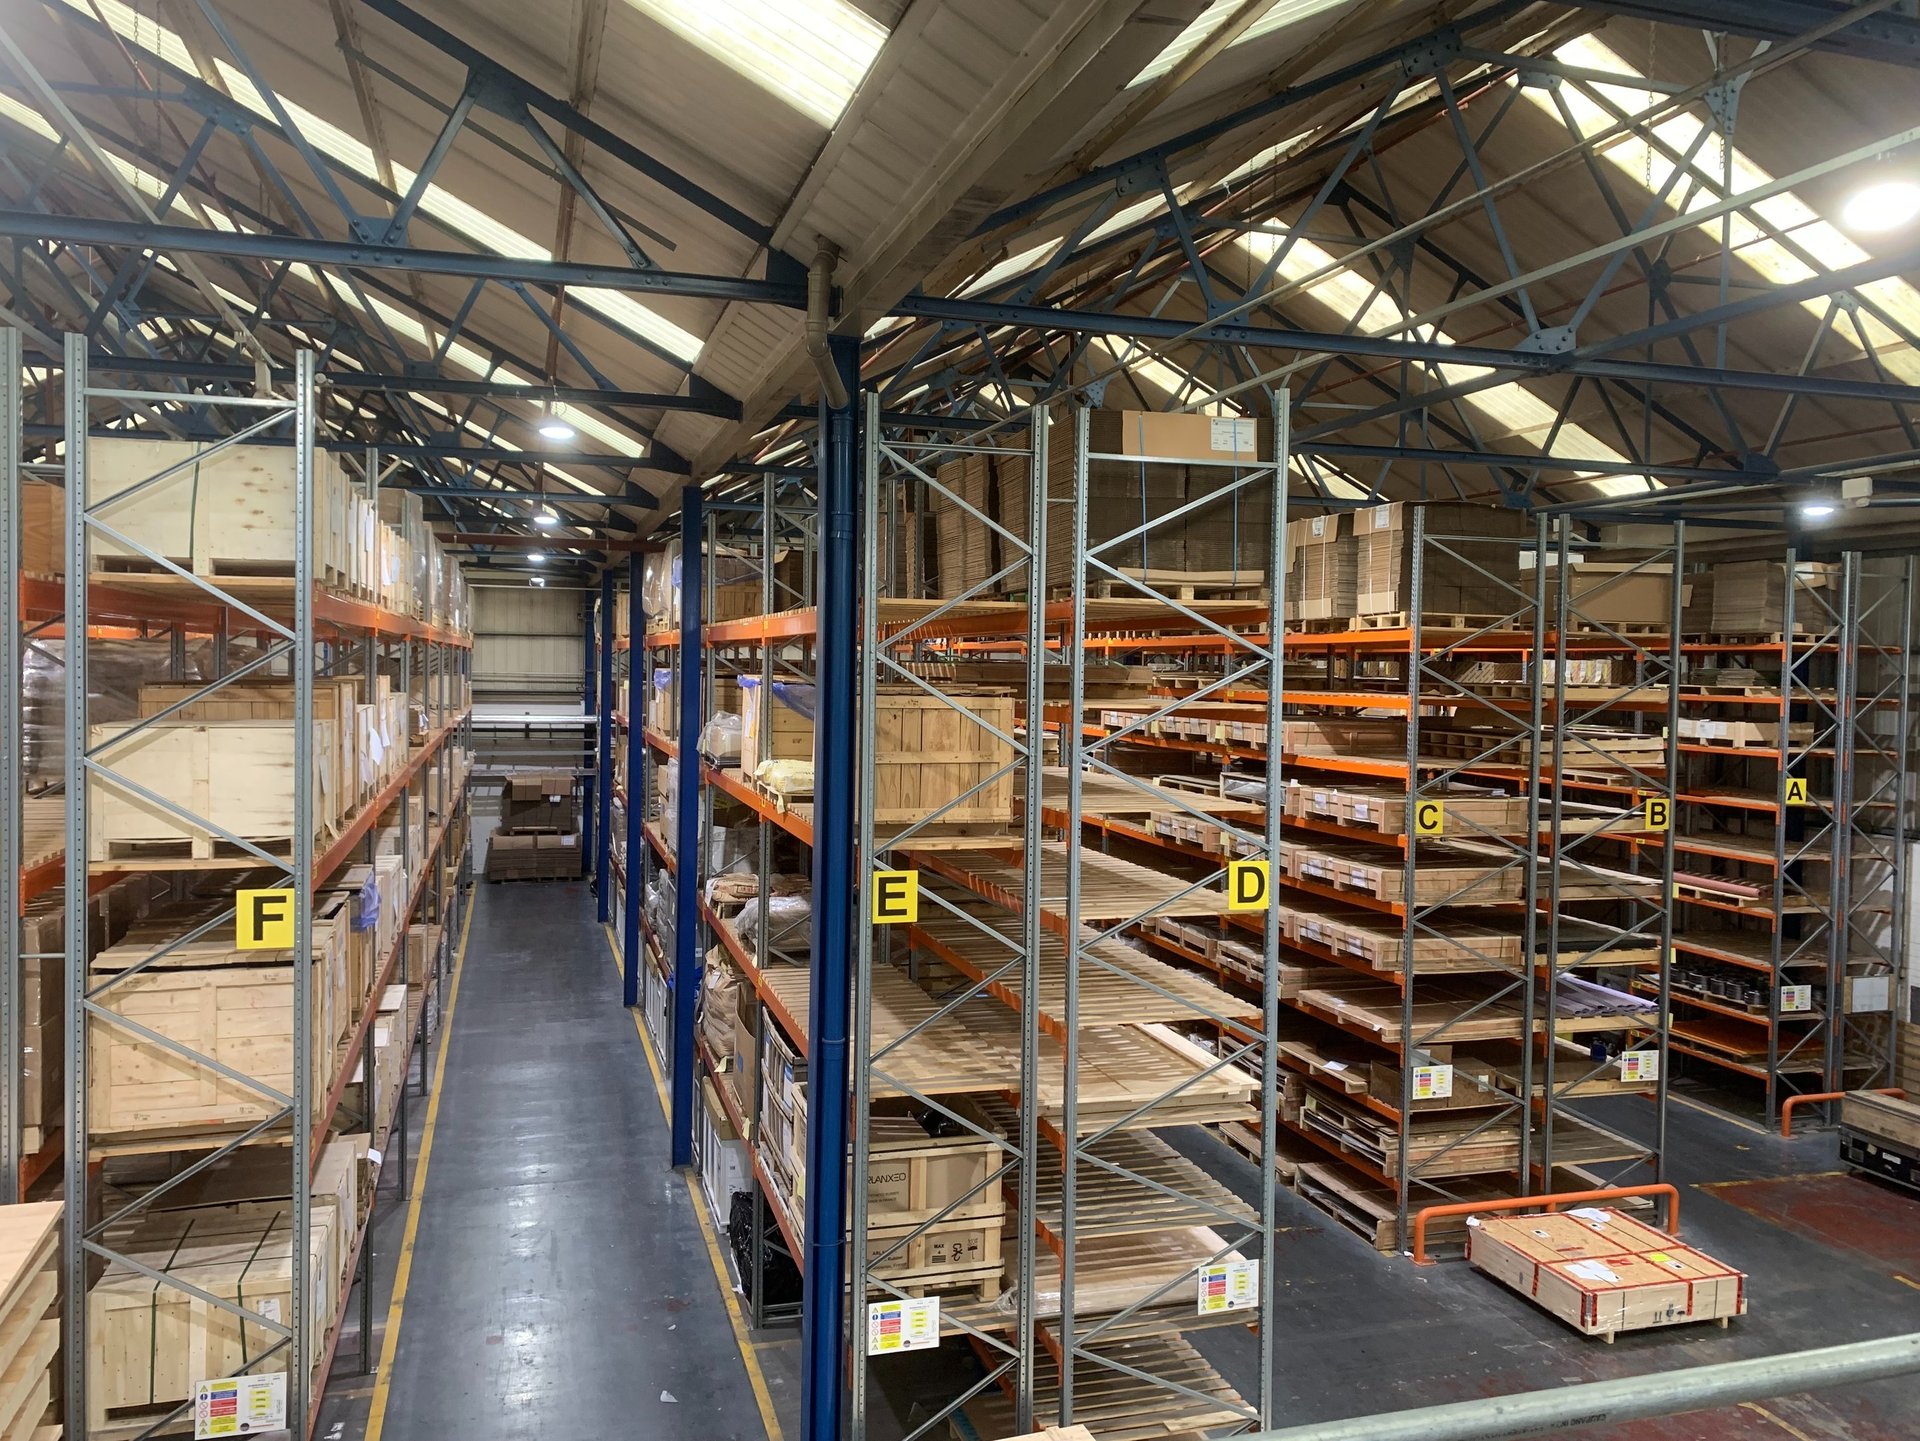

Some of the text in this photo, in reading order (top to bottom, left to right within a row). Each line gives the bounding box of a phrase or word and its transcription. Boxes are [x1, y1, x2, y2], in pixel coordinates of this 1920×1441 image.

[1787, 781, 1803, 801] A
[1418, 804, 1439, 830] C
[1650, 802, 1667, 826] B
[878, 876, 908, 917] E
[1237, 866, 1266, 904] D
[253, 895, 287, 941] F
[867, 1172, 907, 1185] RLANXEO
